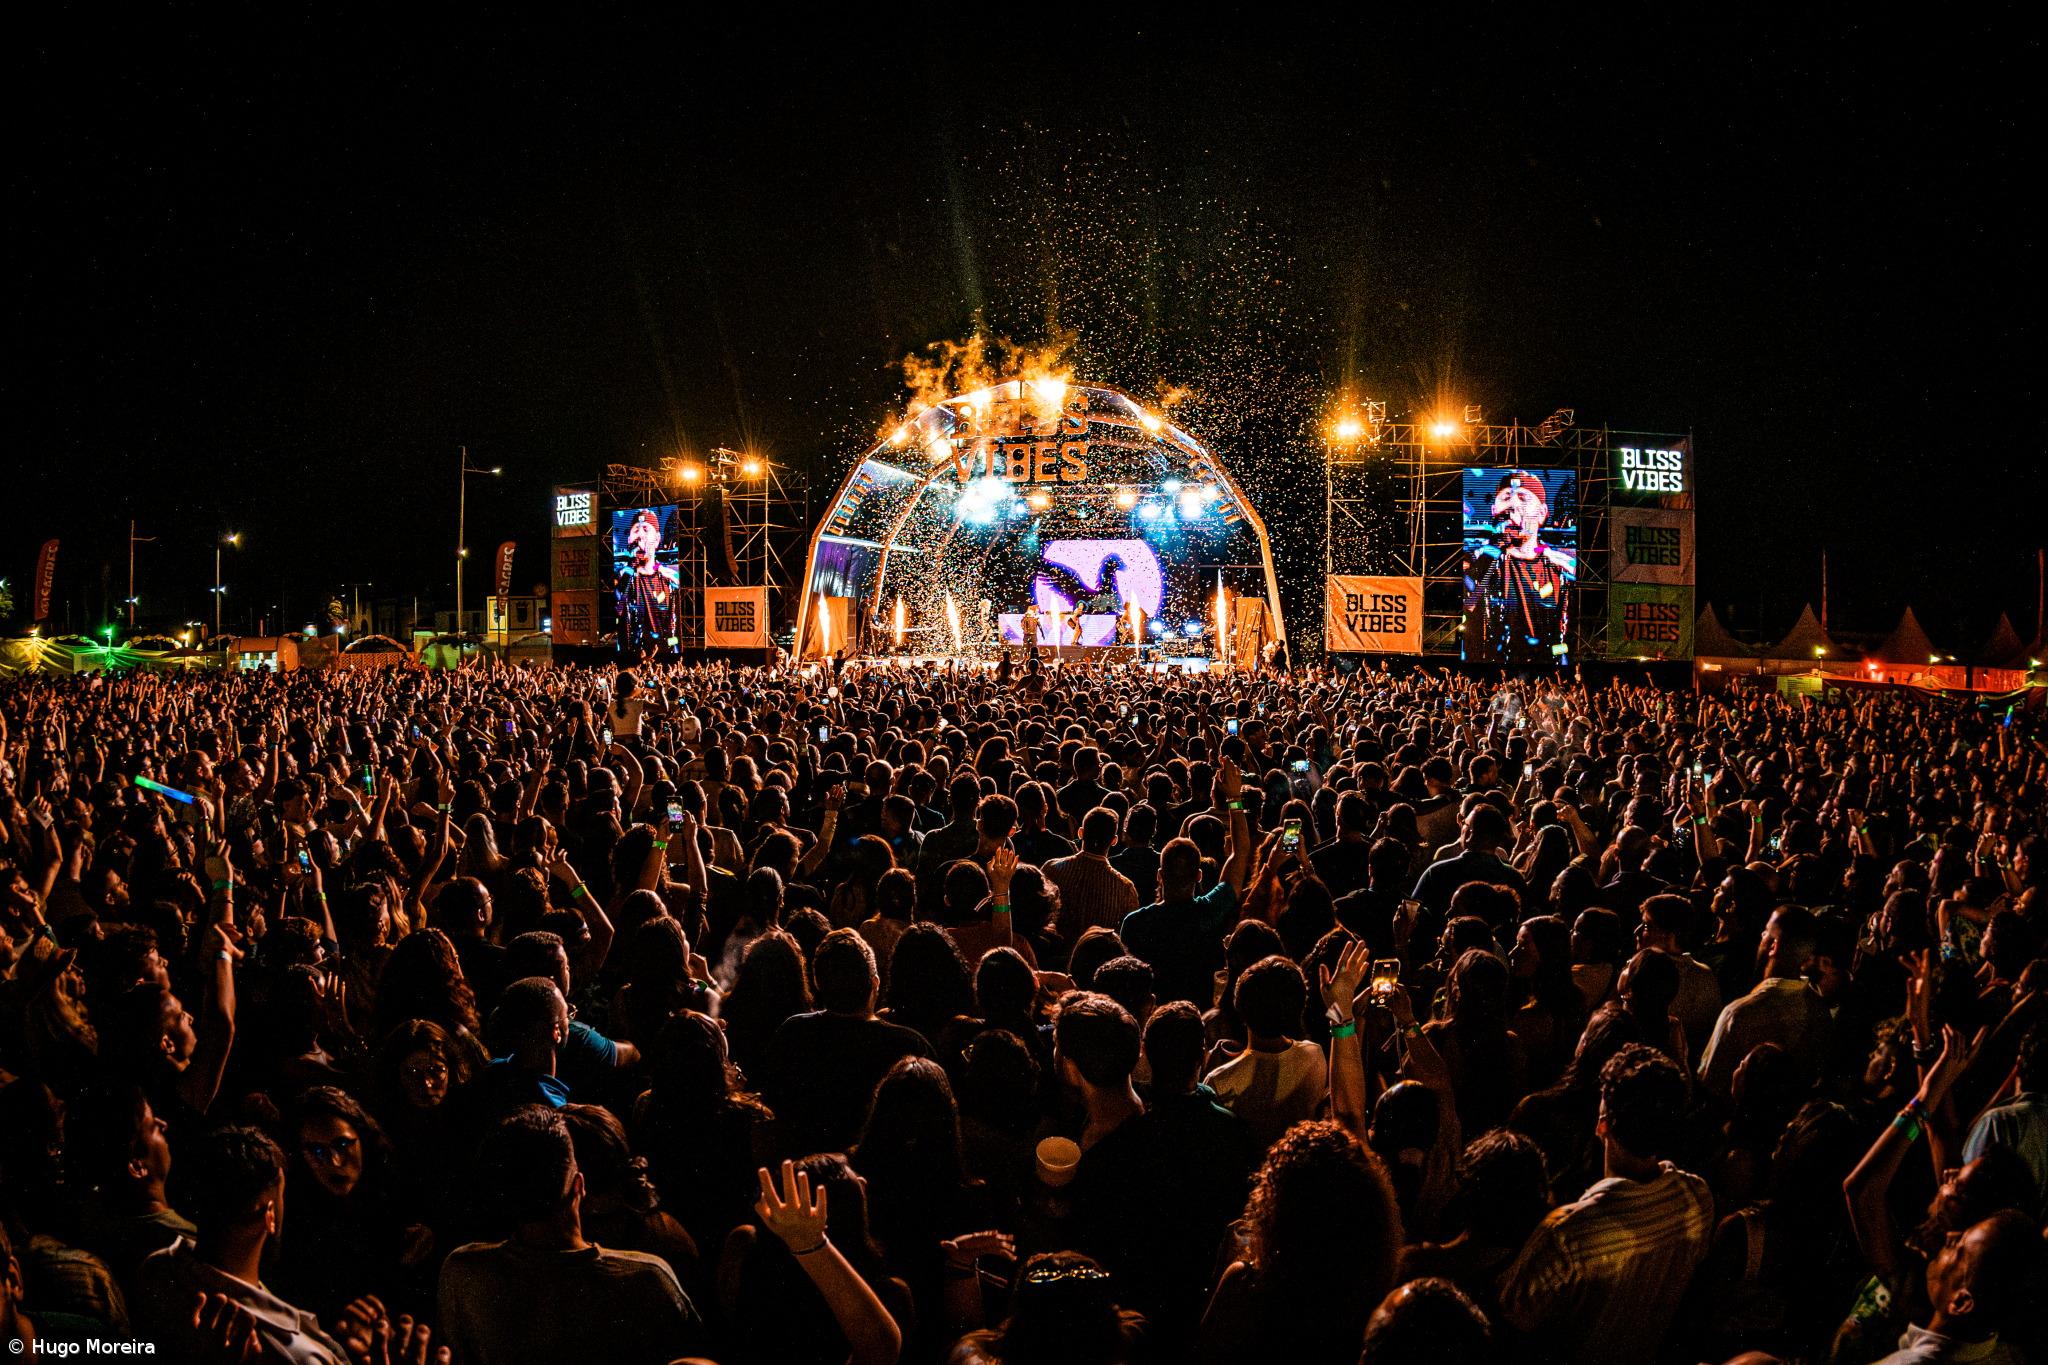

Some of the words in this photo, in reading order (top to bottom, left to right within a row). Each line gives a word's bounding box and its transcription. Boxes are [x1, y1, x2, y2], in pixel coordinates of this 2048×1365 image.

[951, 441, 1088, 483] VIBES
[1620, 448, 1682, 471] BLISS
[1622, 470, 1682, 492] VIBES
[556, 493, 590, 511] BLISS
[557, 509, 591, 526] VIBES
[1625, 525, 1680, 545] BLISS
[1626, 545, 1680, 566] VIBES
[715, 602, 755, 616] BLISS
[1345, 594, 1407, 613] BLISS
[1624, 603, 1680, 622] BLISS
[715, 617, 755, 632] VIBES
[1345, 614, 1407, 633] VIBES
[1624, 622, 1680, 642] VIBES
